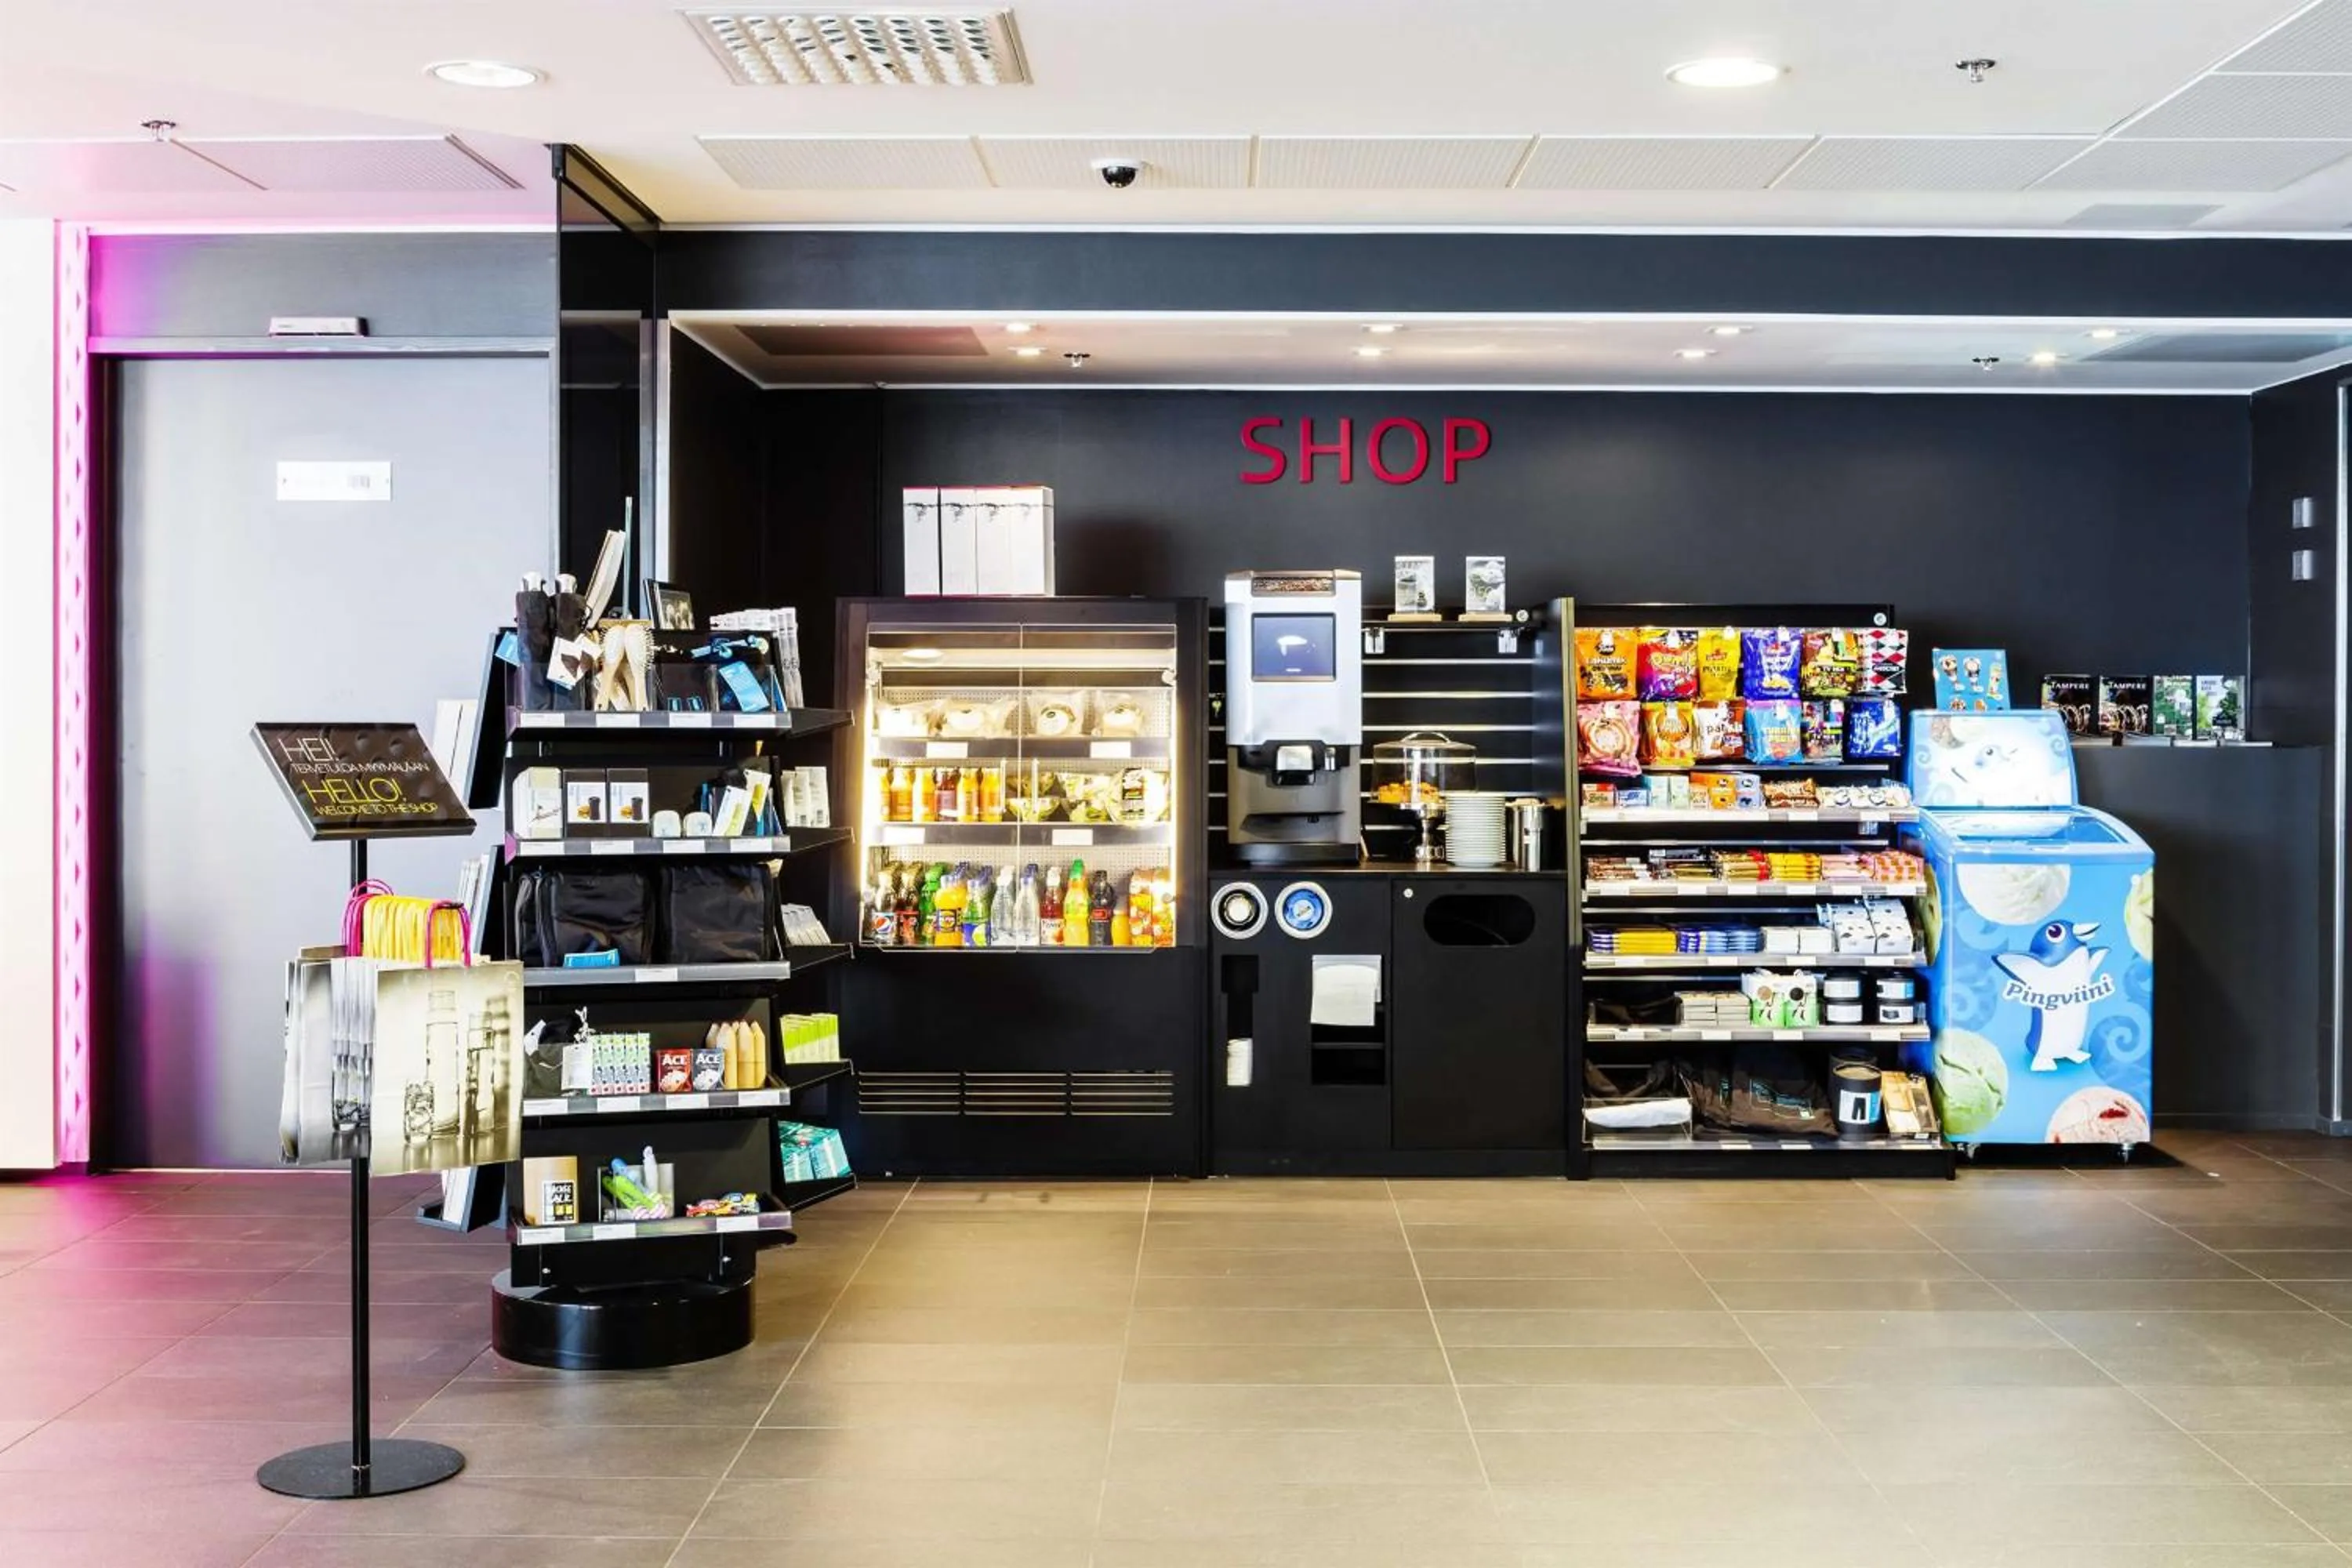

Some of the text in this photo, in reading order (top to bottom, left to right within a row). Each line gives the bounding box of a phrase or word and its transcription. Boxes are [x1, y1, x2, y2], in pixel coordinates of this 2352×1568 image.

[1240, 416, 1492, 485] SHOP
[2051, 681, 2090, 690] TAMPERE
[2109, 681, 2147, 690] TAMPERE
[278, 738, 340, 762] HEI!
[302, 778, 408, 804] HELLO!
[314, 802, 438, 816] WELCOME TO THE SHOP
[2006, 976, 2113, 1011] Pingviini
[662, 1053, 688, 1065] ACE
[695, 1053, 720, 1065] ACE
